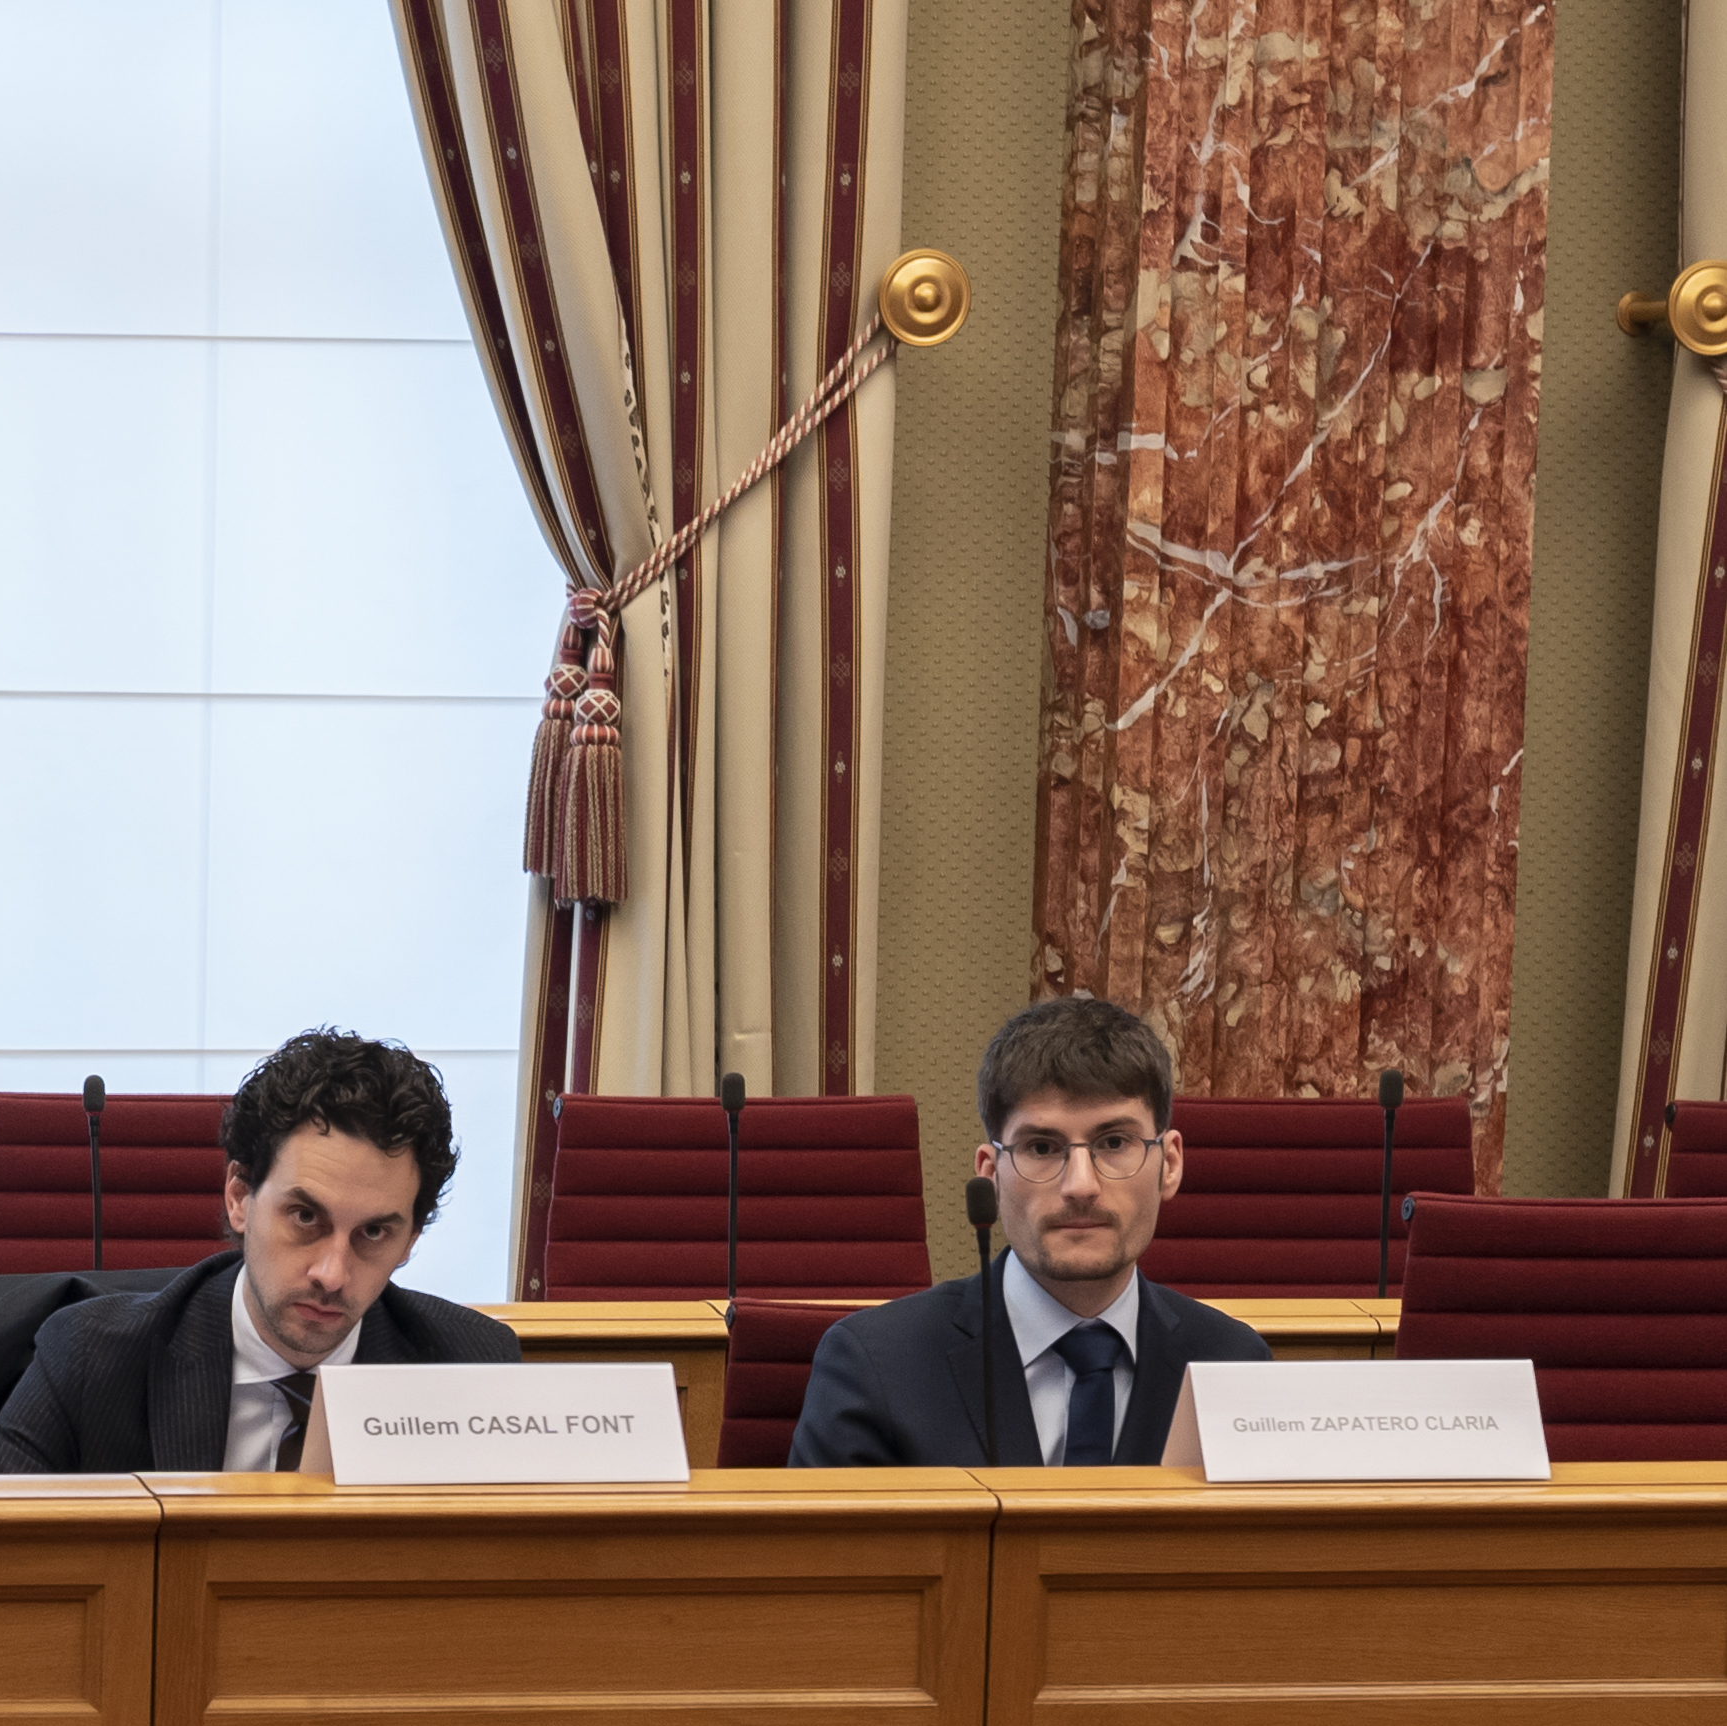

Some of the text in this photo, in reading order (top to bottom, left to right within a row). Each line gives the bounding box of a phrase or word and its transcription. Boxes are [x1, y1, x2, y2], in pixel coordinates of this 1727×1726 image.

[363, 1415, 634, 1435] Guillem CASAL FONT
[1233, 1415, 1499, 1432] Guillem ZAPATERO CLARIA
